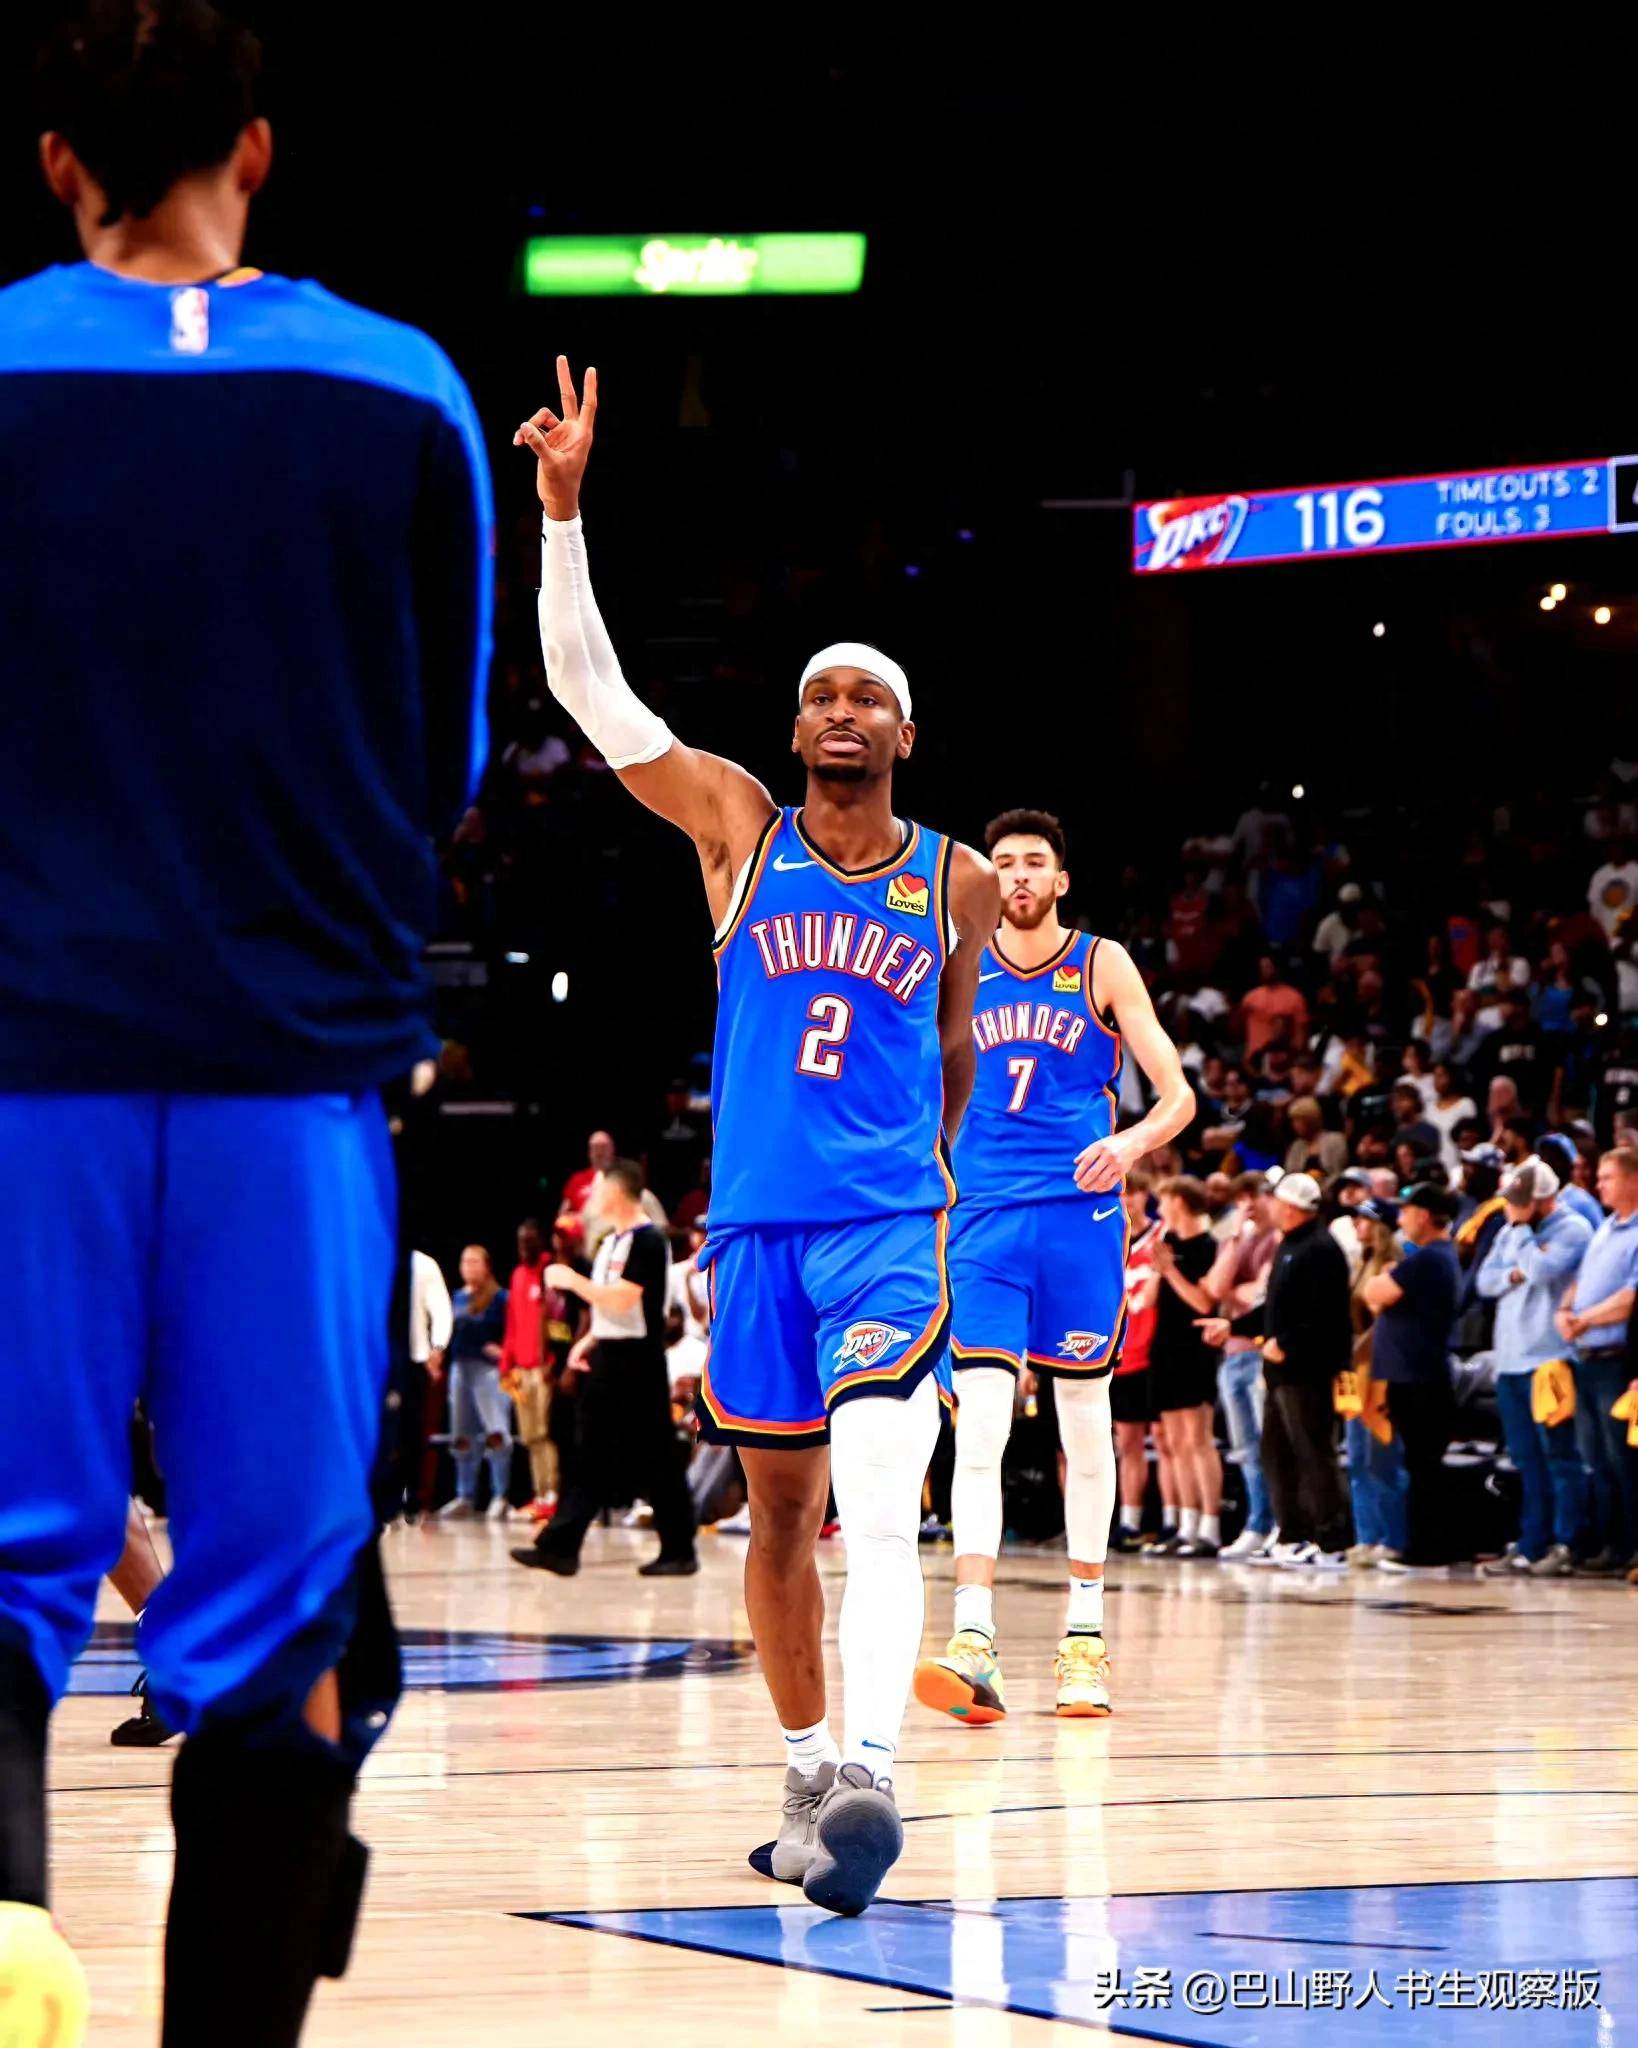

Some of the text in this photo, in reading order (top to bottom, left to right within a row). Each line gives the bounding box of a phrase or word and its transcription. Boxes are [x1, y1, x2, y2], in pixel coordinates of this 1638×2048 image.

[1437, 471, 1571, 504] TIMEOUTS
[1582, 467, 1599, 495] 2
[1295, 488, 1385, 552] 116
[1436, 504, 1550, 538] FOULS 3
[750, 912, 935, 1005] THUNDER
[797, 993, 852, 1079] 2
[972, 1002, 1088, 1056] THUNDER
[1007, 1056, 1037, 1113] 7
